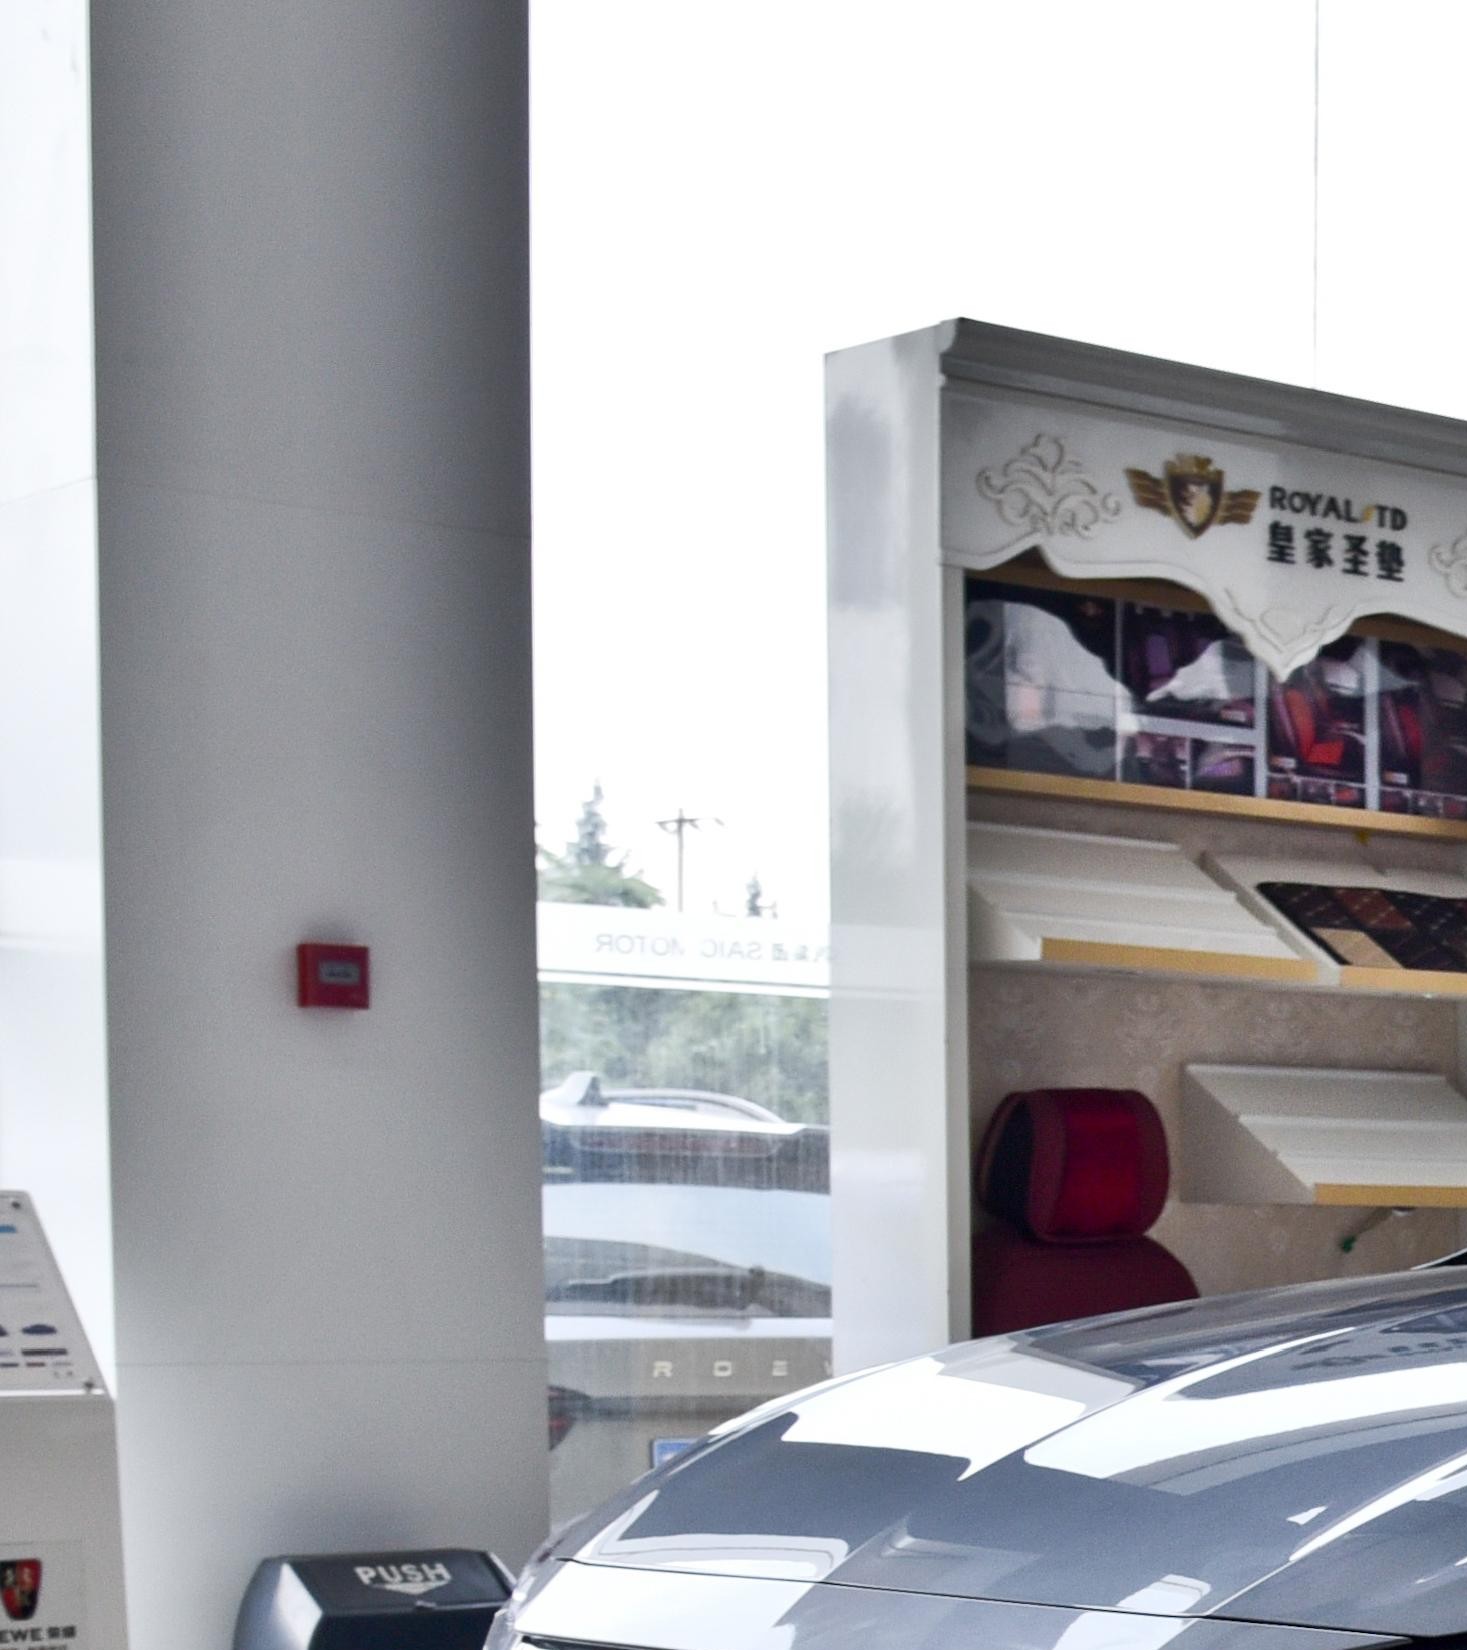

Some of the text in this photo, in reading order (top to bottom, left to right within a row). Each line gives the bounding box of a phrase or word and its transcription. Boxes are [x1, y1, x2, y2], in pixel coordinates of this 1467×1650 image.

[1267, 520, 1404, 583] 皇家圣垫
[354, 1563, 452, 1585] PUSH
